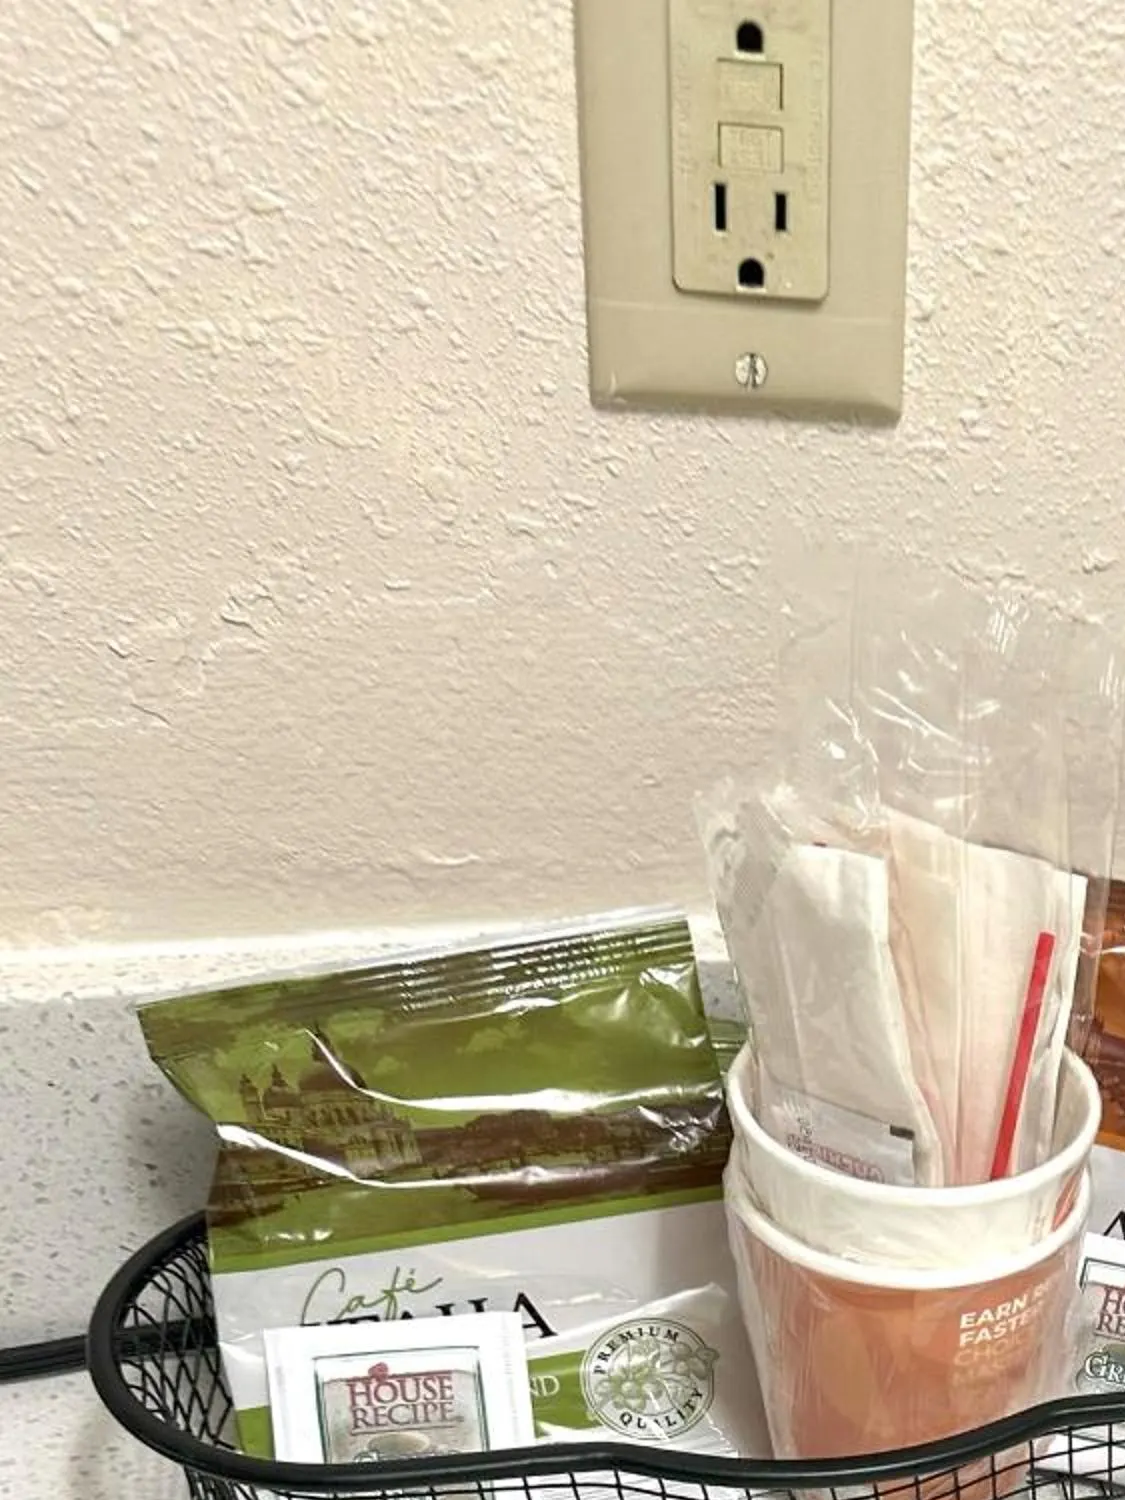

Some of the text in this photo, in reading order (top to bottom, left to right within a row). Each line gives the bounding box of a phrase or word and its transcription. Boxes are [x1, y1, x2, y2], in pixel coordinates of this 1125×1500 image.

[301, 1266, 443, 1323] Café
[959, 1293, 1028, 1330] EARN
[593, 1326, 681, 1375] PREMIUM
[346, 1374, 455, 1407] HOUSE
[351, 1402, 455, 1430] RECIPE
